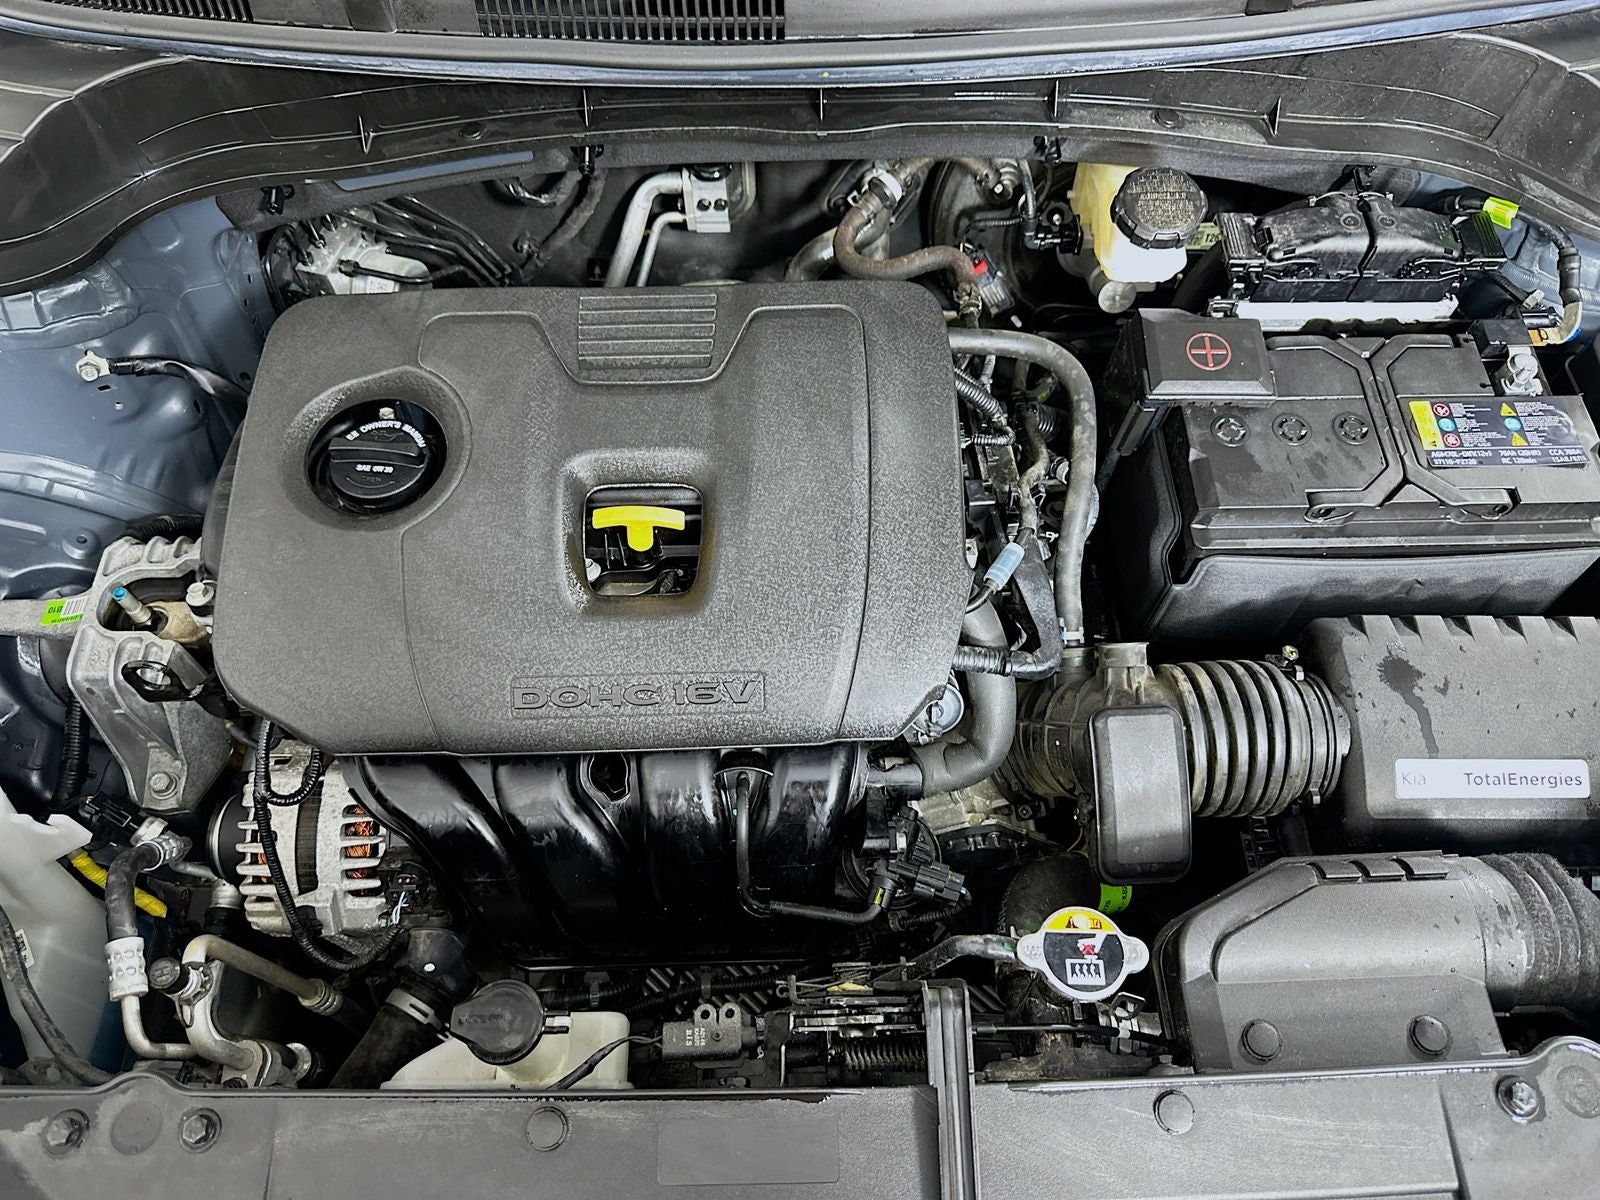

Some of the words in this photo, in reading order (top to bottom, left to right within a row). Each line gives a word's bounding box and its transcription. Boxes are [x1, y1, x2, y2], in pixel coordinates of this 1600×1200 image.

[359, 420, 402, 433] OWNER'S
[1548, 448, 1564, 456] CCA
[355, 463, 372, 472] SAE
[513, 683, 660, 710] DOHC
[672, 681, 758, 706] 16V
[1402, 771, 1427, 785] Kia
[1463, 771, 1582, 789] TotalEnergies
